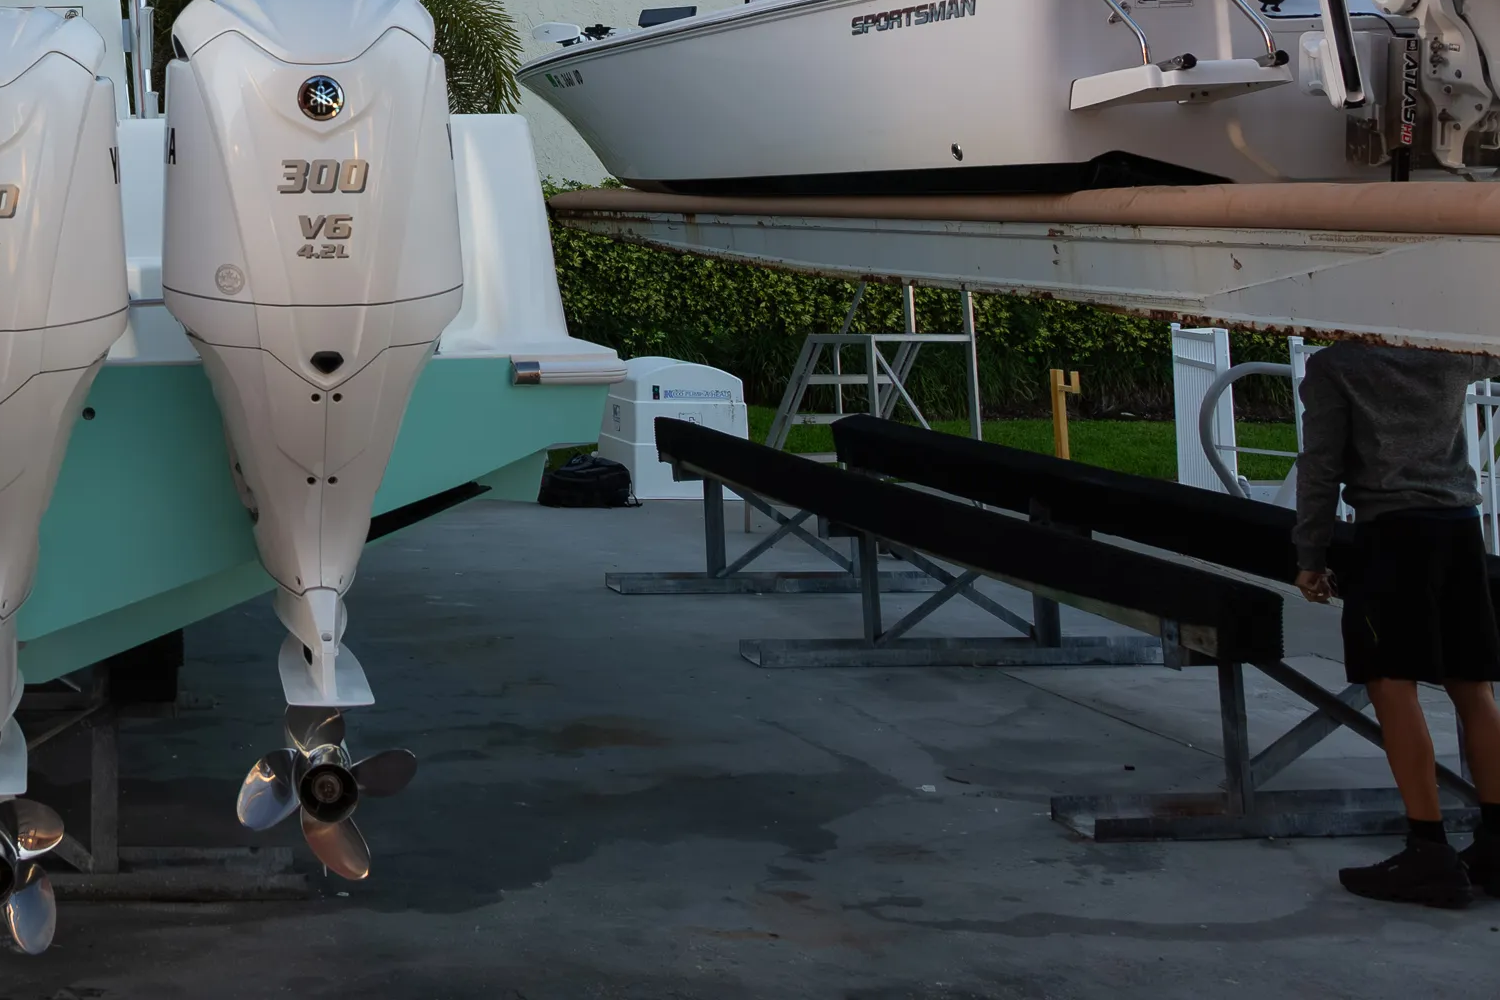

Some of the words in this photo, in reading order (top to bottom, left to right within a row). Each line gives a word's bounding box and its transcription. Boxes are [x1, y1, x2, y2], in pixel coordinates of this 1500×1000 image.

[1402, 52, 1418, 126] ATLAS
[1401, 123, 1412, 146] HD
[277, 158, 370, 194] 300
[298, 213, 354, 240] V6
[296, 243, 350, 259] 4.2L
